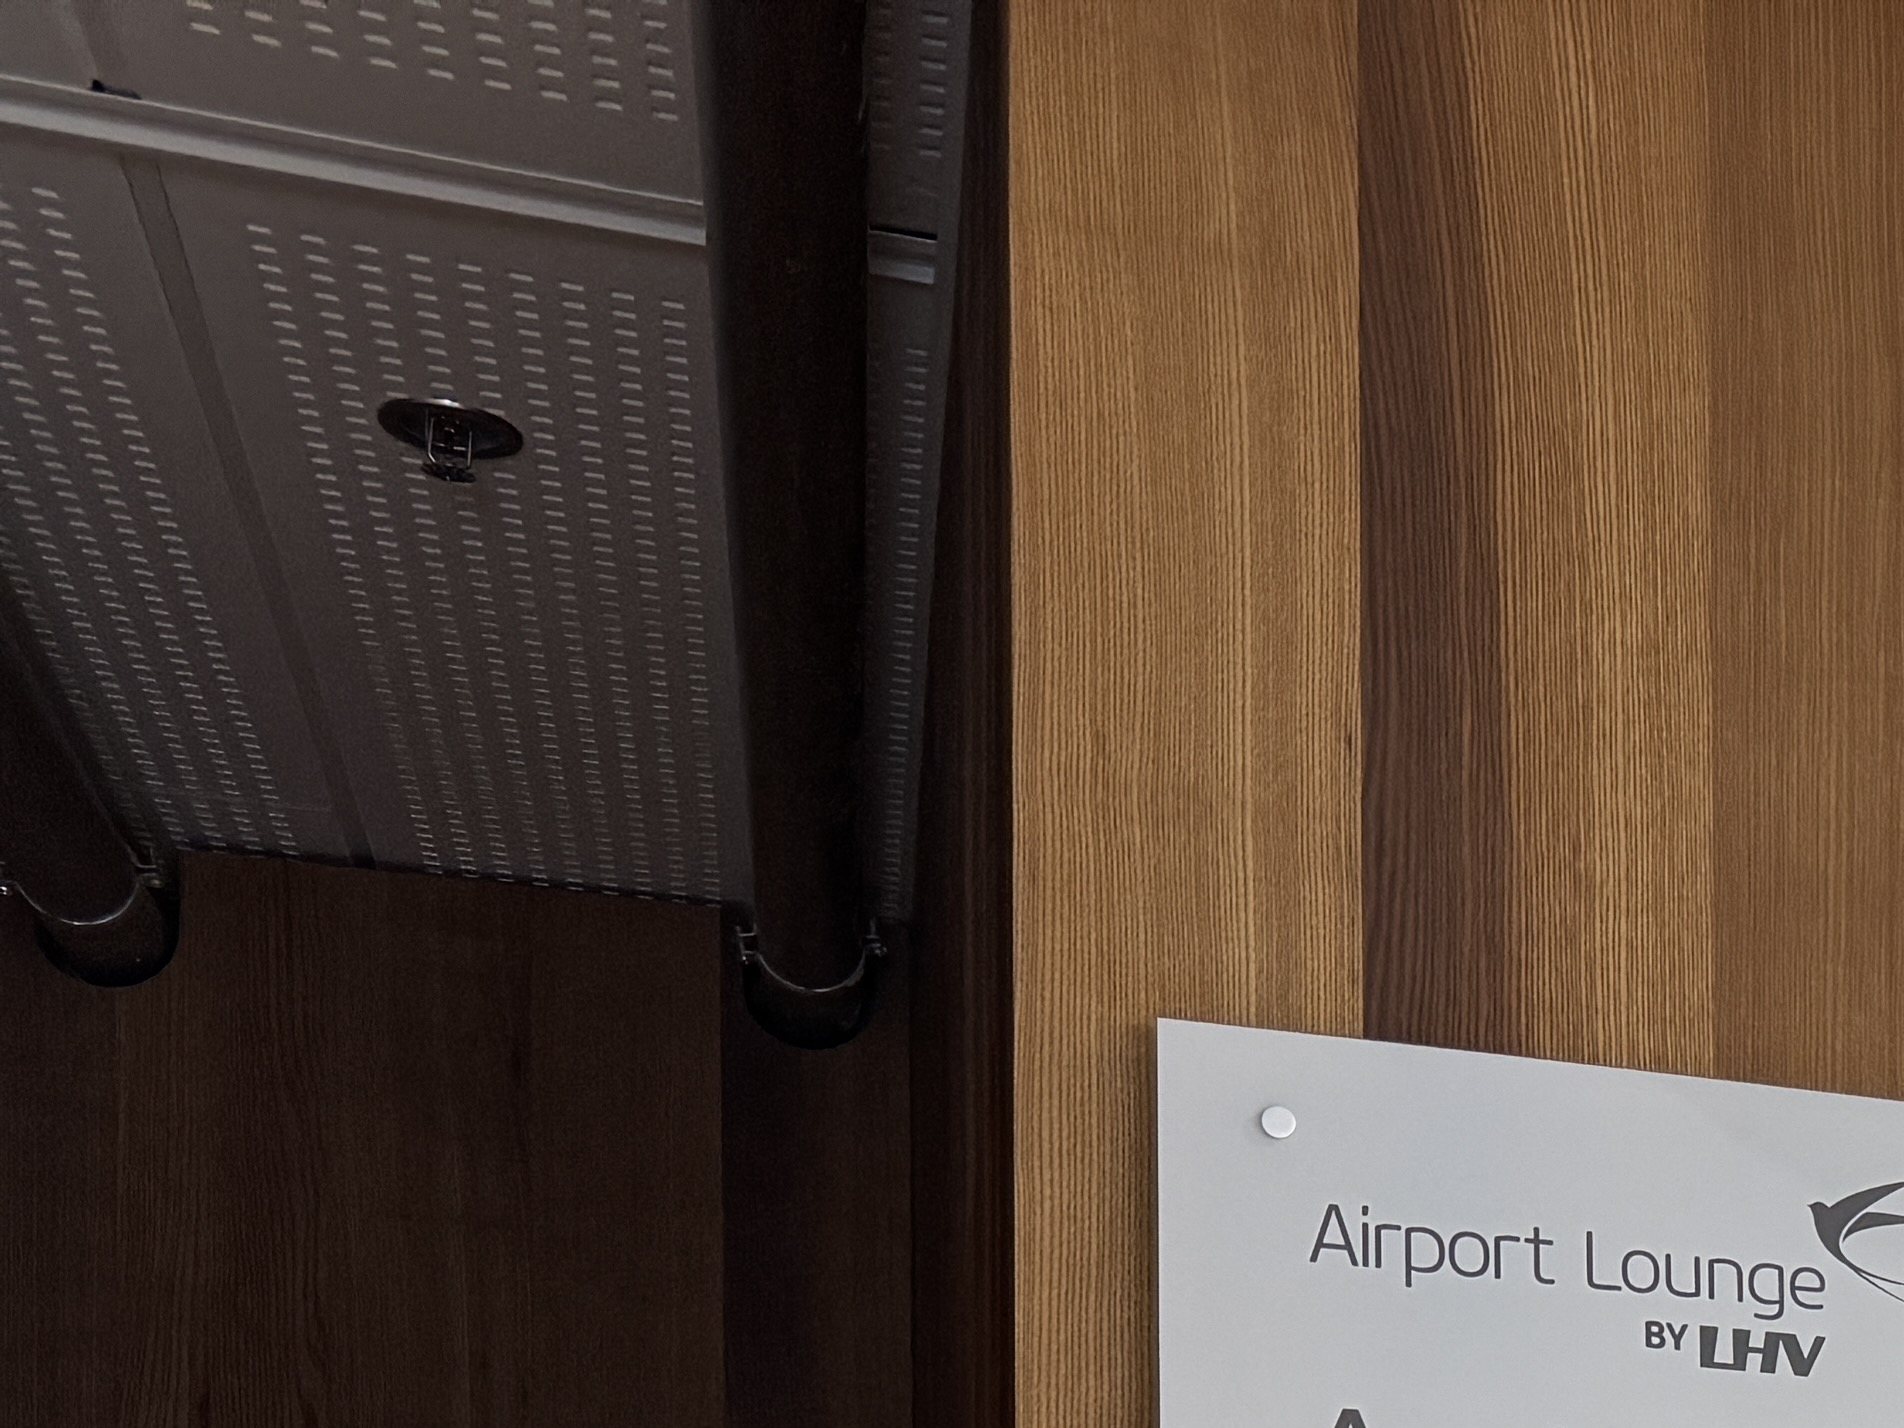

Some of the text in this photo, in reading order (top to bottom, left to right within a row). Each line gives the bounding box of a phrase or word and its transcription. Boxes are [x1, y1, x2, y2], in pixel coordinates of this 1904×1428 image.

[1309, 1204, 1826, 1320] Airport Lounge
[1644, 1321, 1826, 1377] BY LHV
